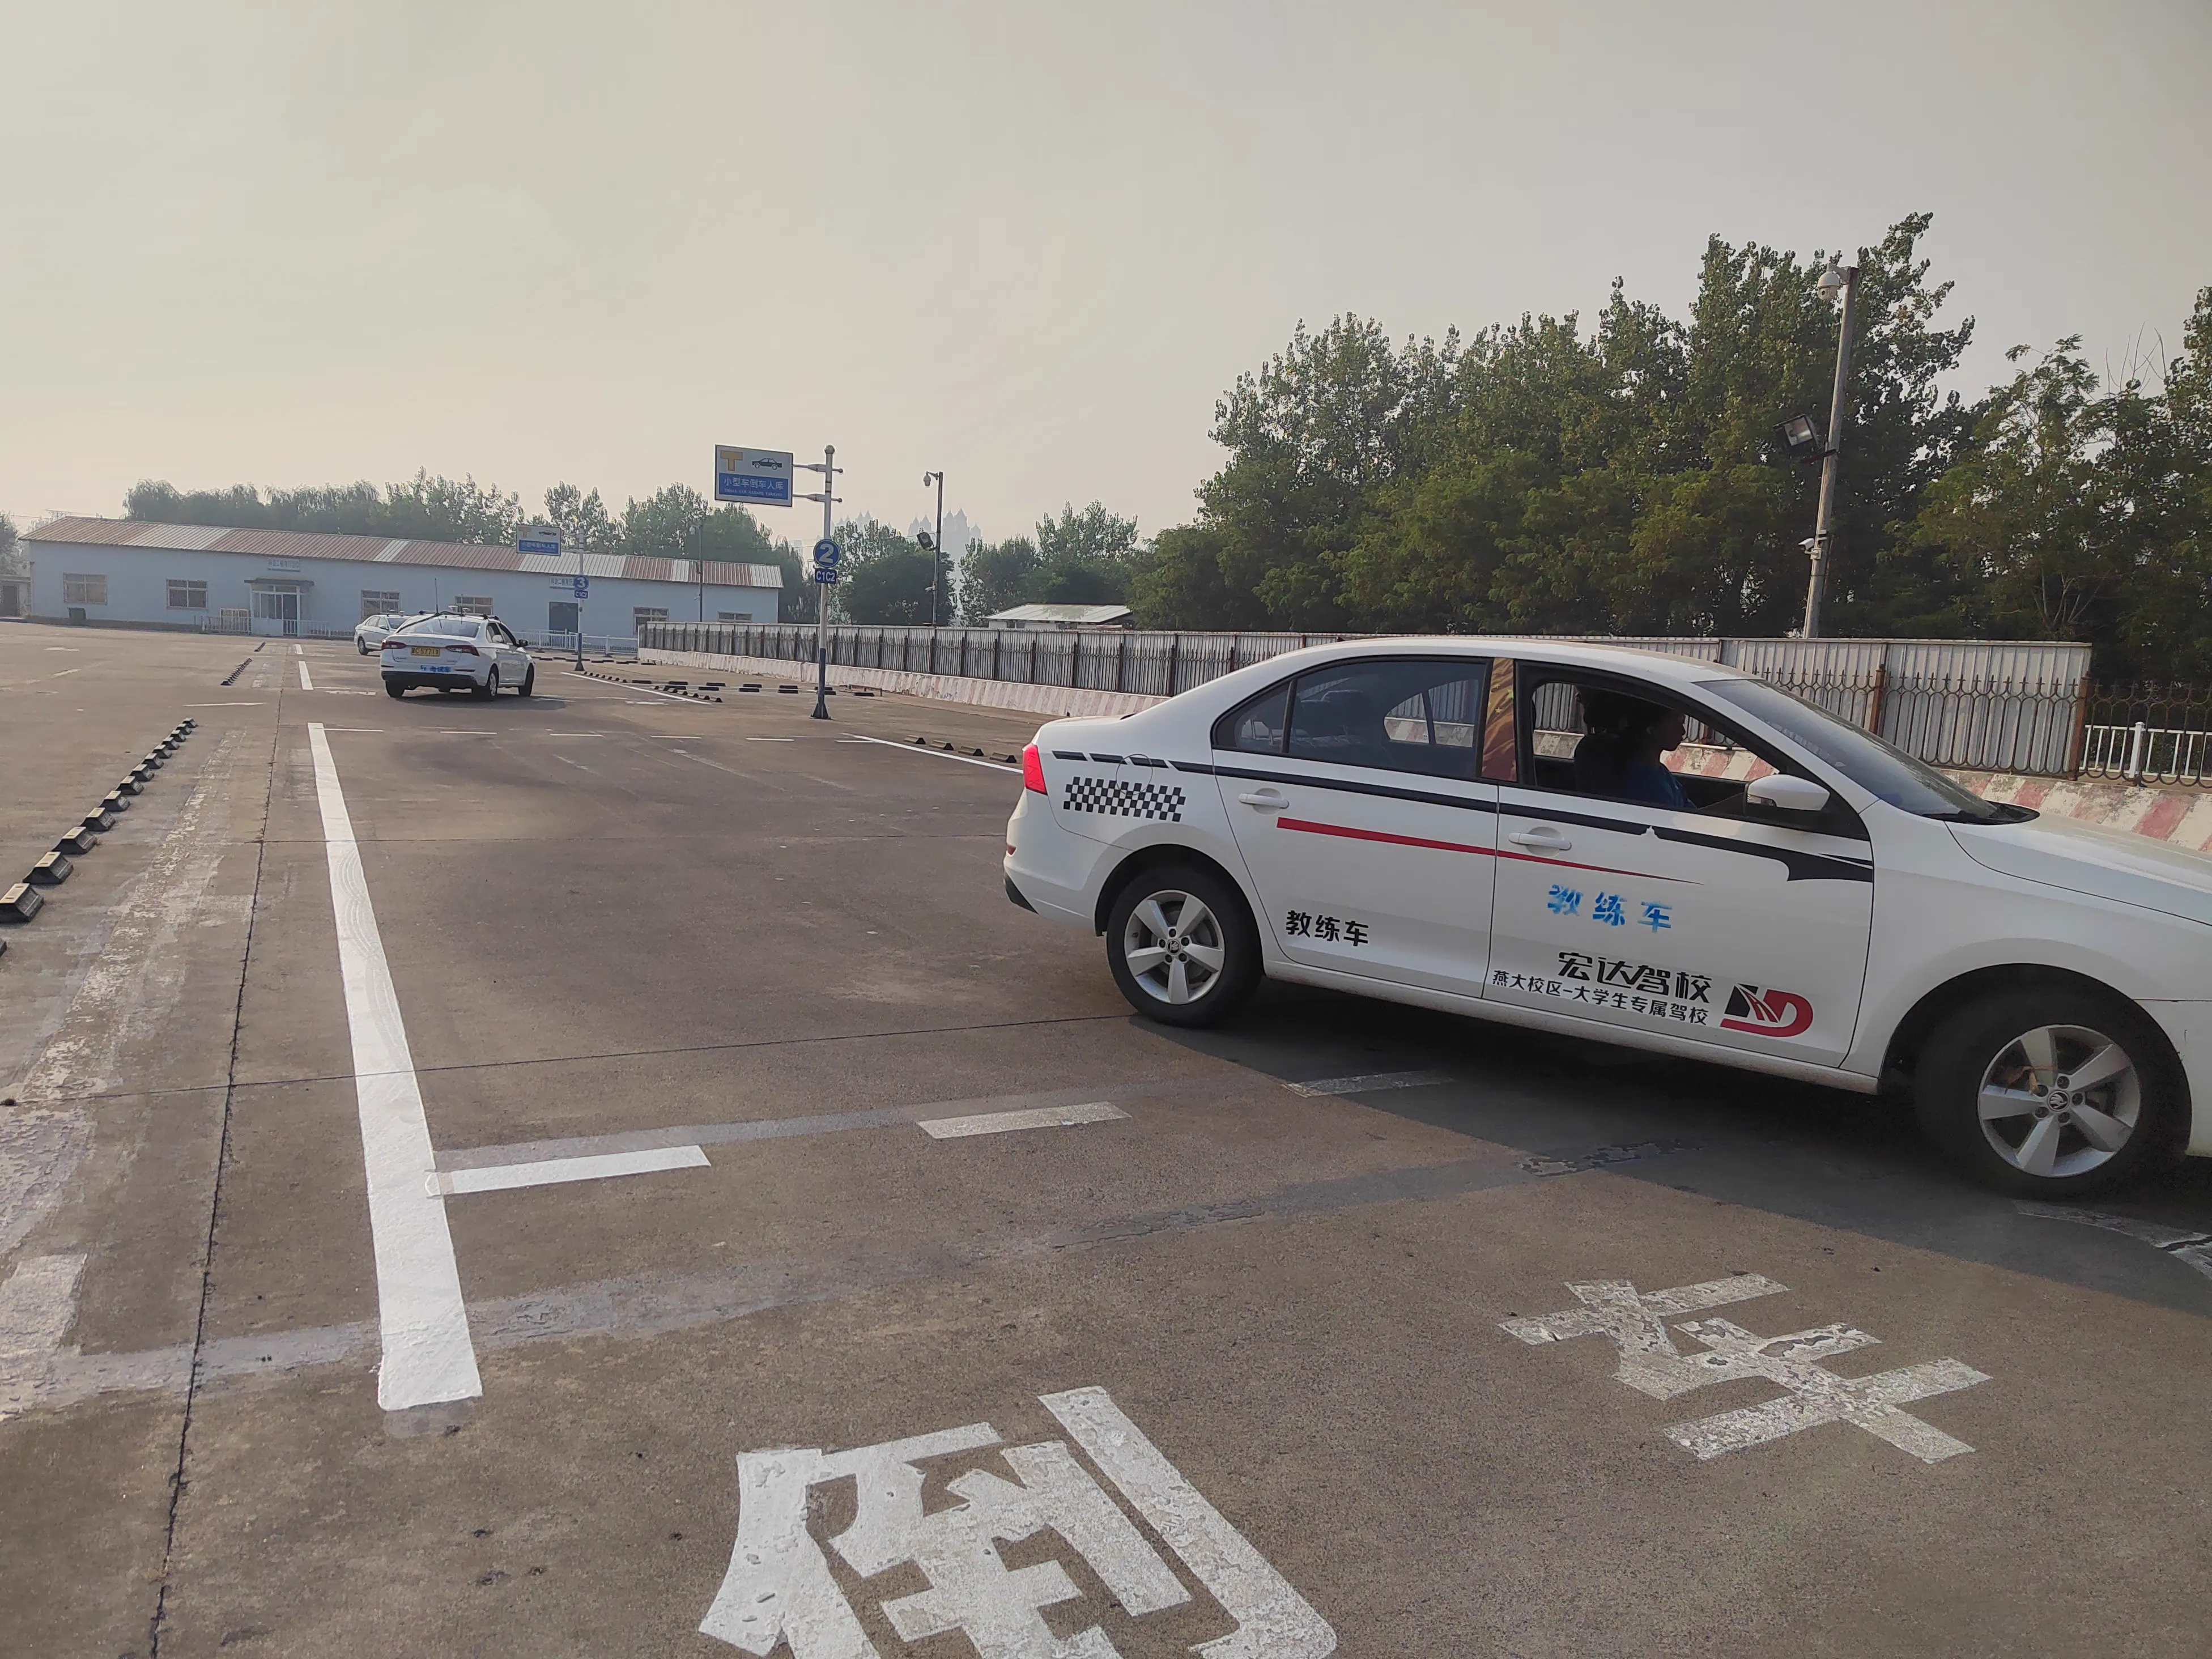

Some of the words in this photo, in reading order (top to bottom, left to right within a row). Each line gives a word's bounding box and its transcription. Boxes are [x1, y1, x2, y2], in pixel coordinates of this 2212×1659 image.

[724, 477, 784, 491] 小型车倒车入库
[819, 543, 834, 564] 2
[577, 577, 585, 588] 3
[816, 571, 836, 582] C1C2
[1547, 884, 1673, 933] 教练车
[1286, 910, 1369, 947] 教练车
[1558, 951, 1712, 1004] 宏达驾校
